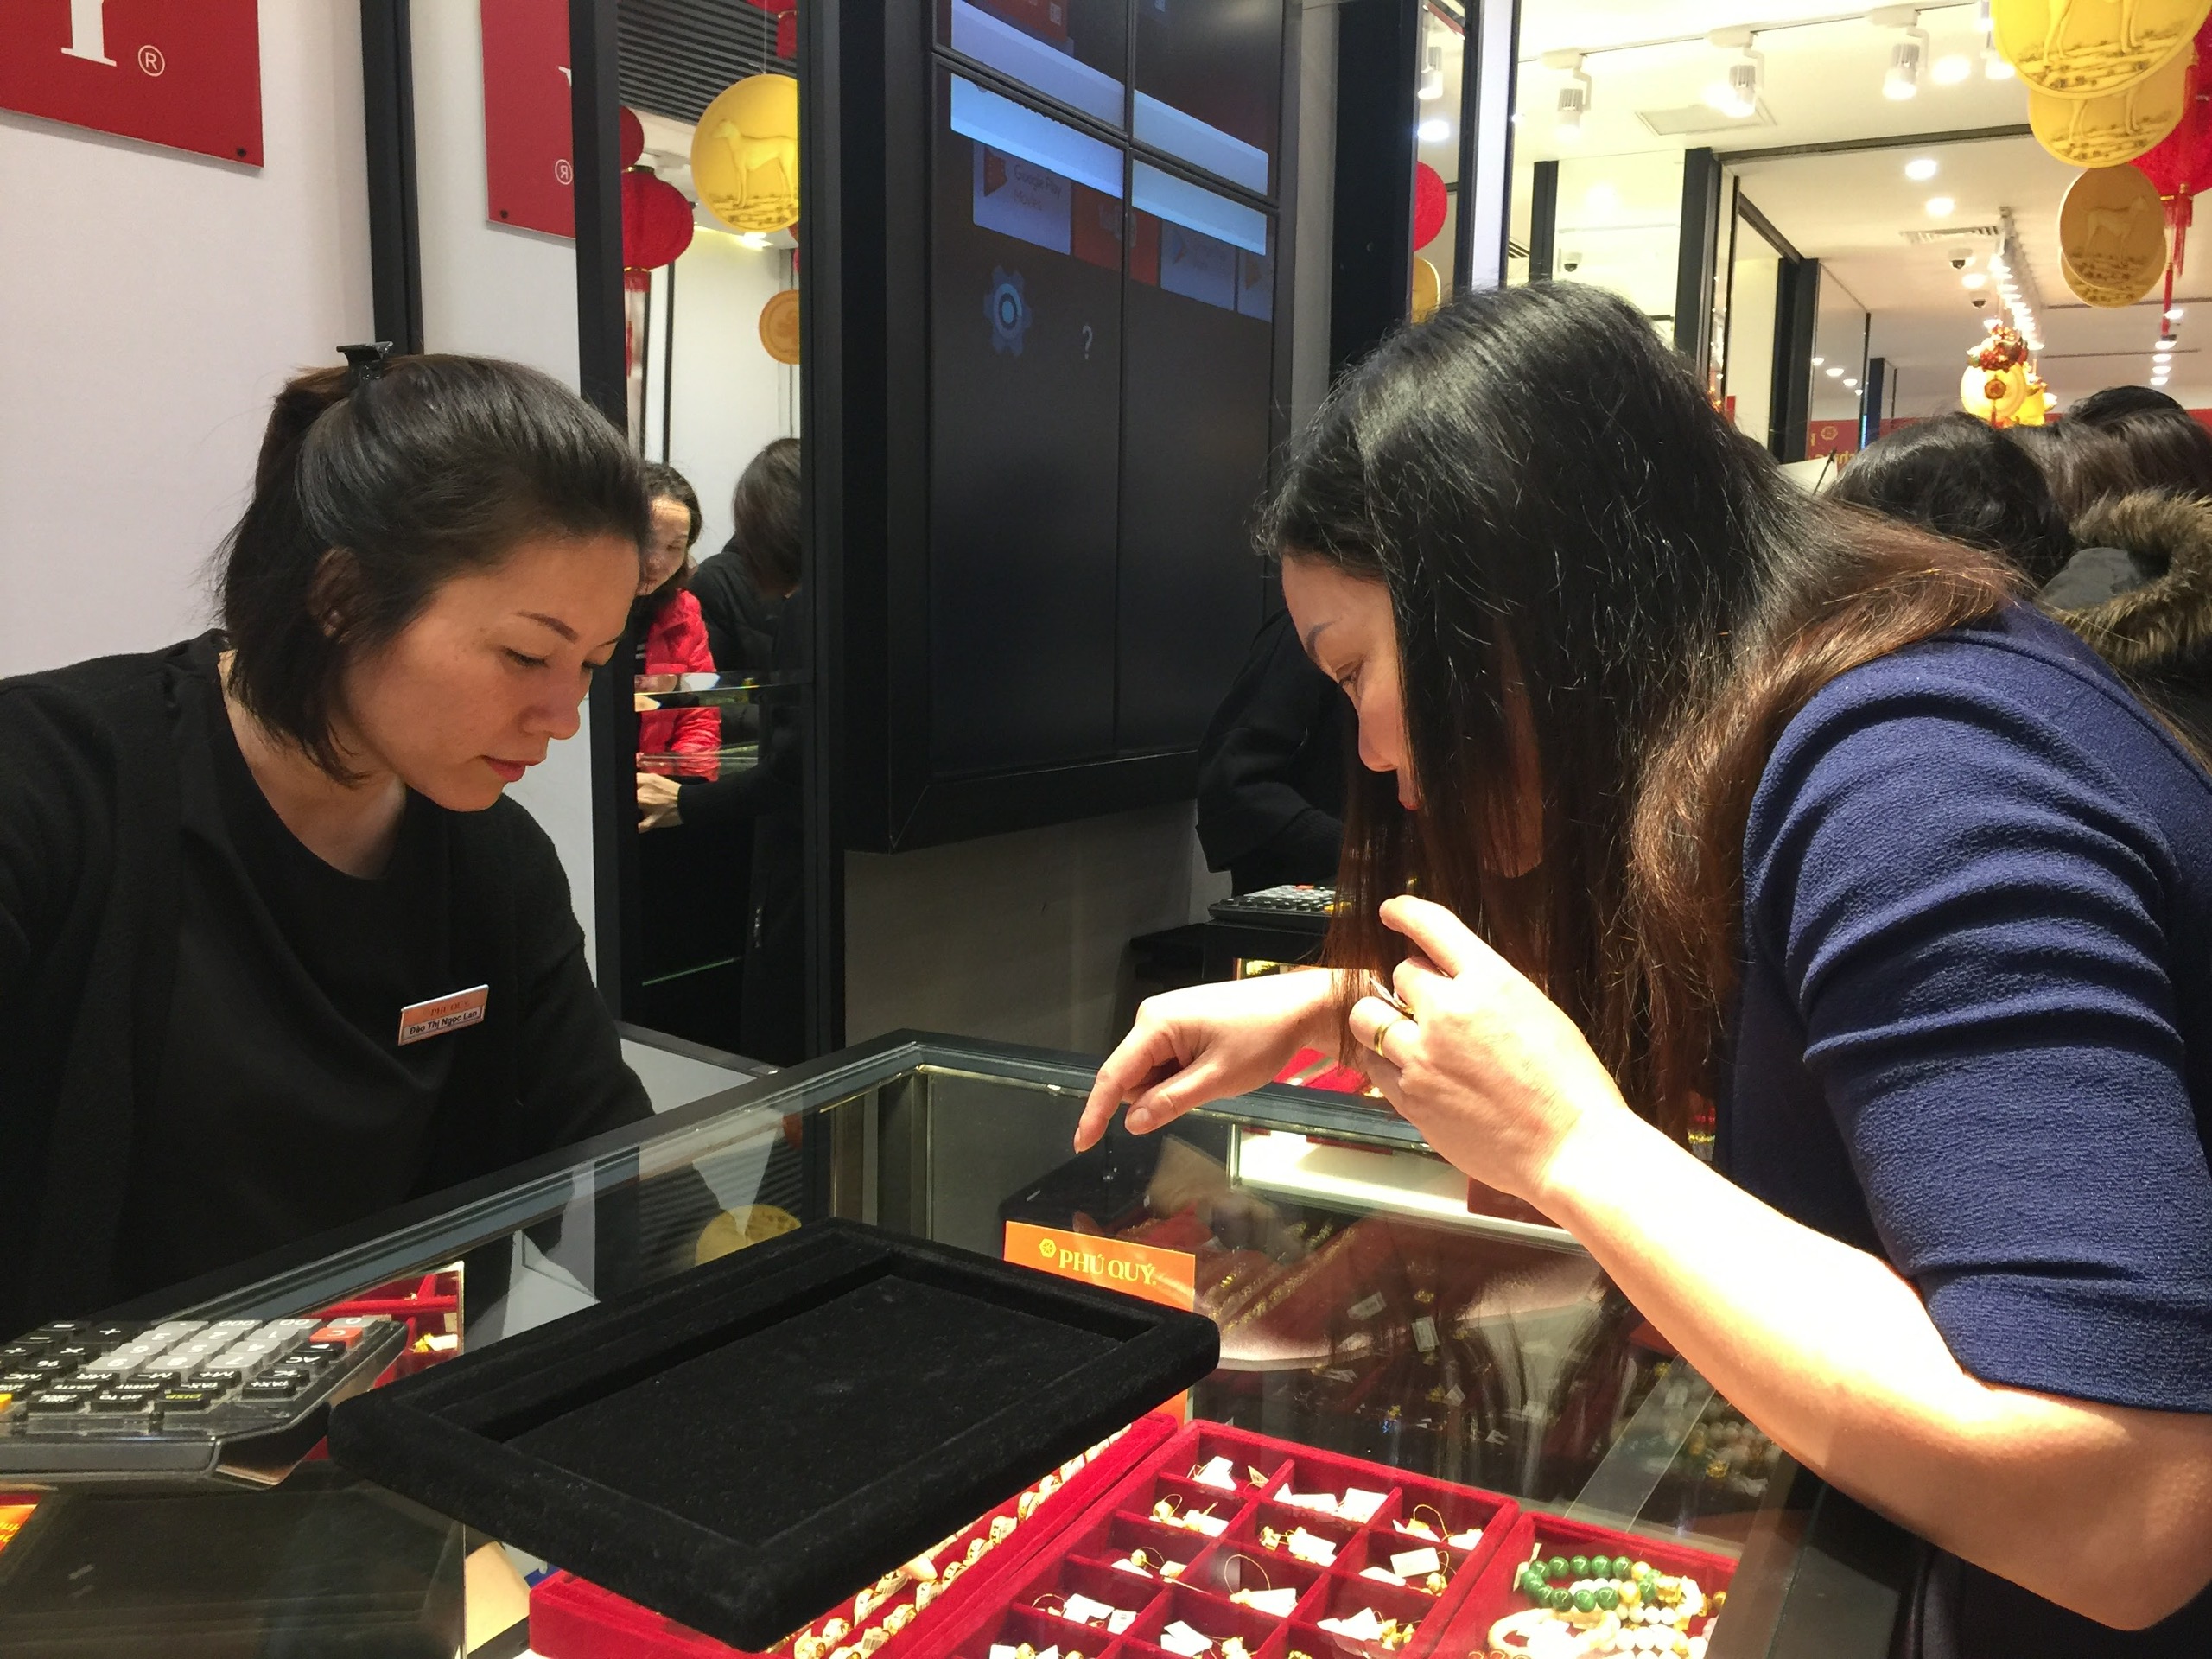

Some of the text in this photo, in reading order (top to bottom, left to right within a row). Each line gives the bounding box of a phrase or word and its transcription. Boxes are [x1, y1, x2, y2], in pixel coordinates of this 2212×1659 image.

[442, 1015, 462, 1027] Ngọc
[463, 1011, 478, 1020] Lan
[1058, 1249, 1105, 1275] PHÚ
